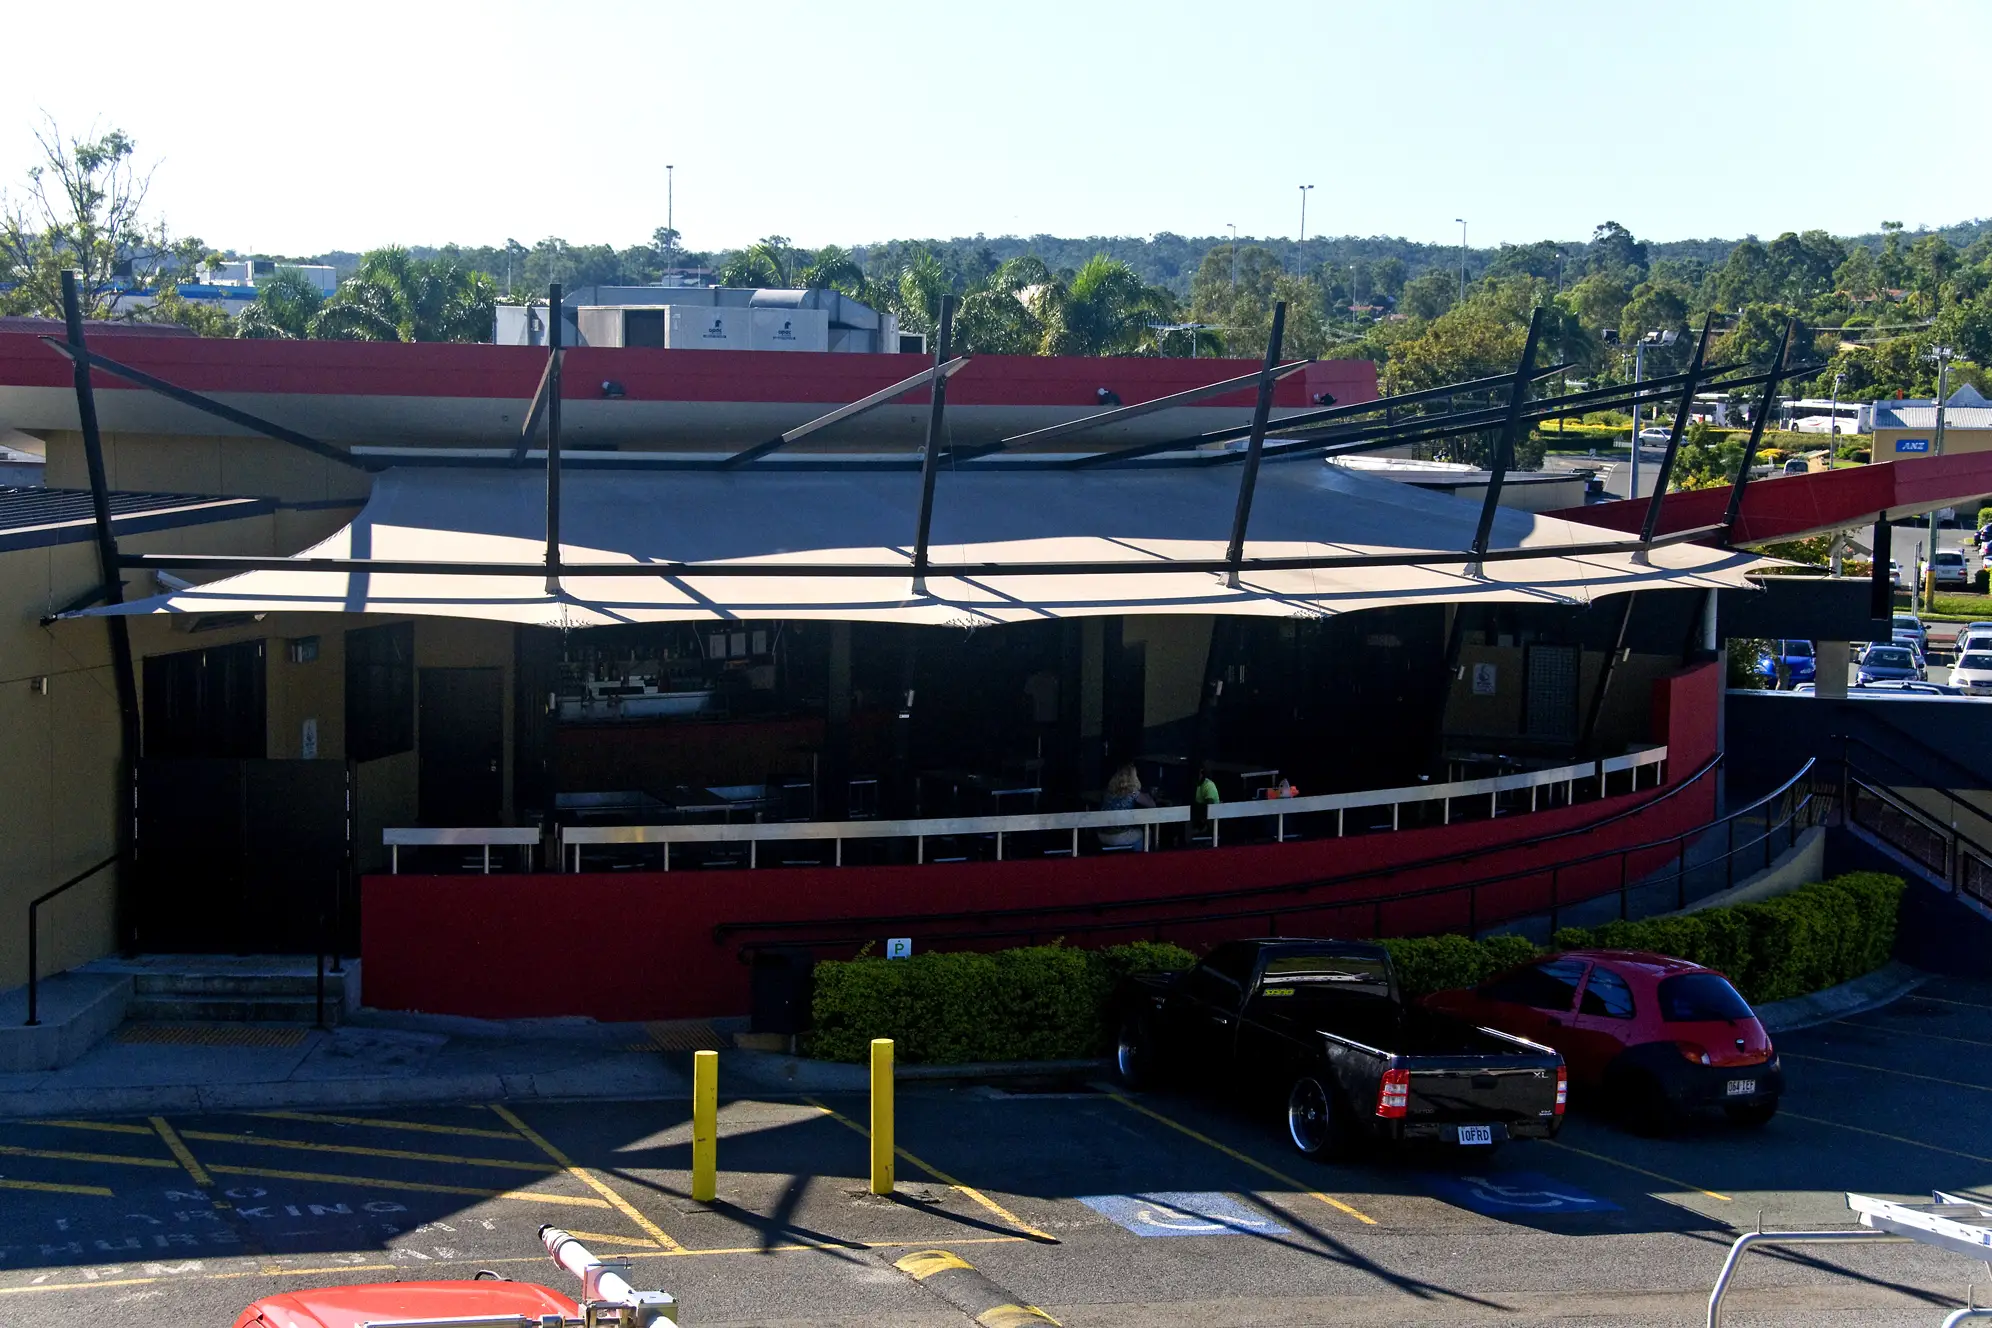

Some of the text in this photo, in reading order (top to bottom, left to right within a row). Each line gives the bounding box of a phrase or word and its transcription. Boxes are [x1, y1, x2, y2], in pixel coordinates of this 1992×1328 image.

[1901, 442, 1925, 450] ANZ
[1532, 1071, 1549, 1079] XL
[164, 1187, 268, 1202] NO
